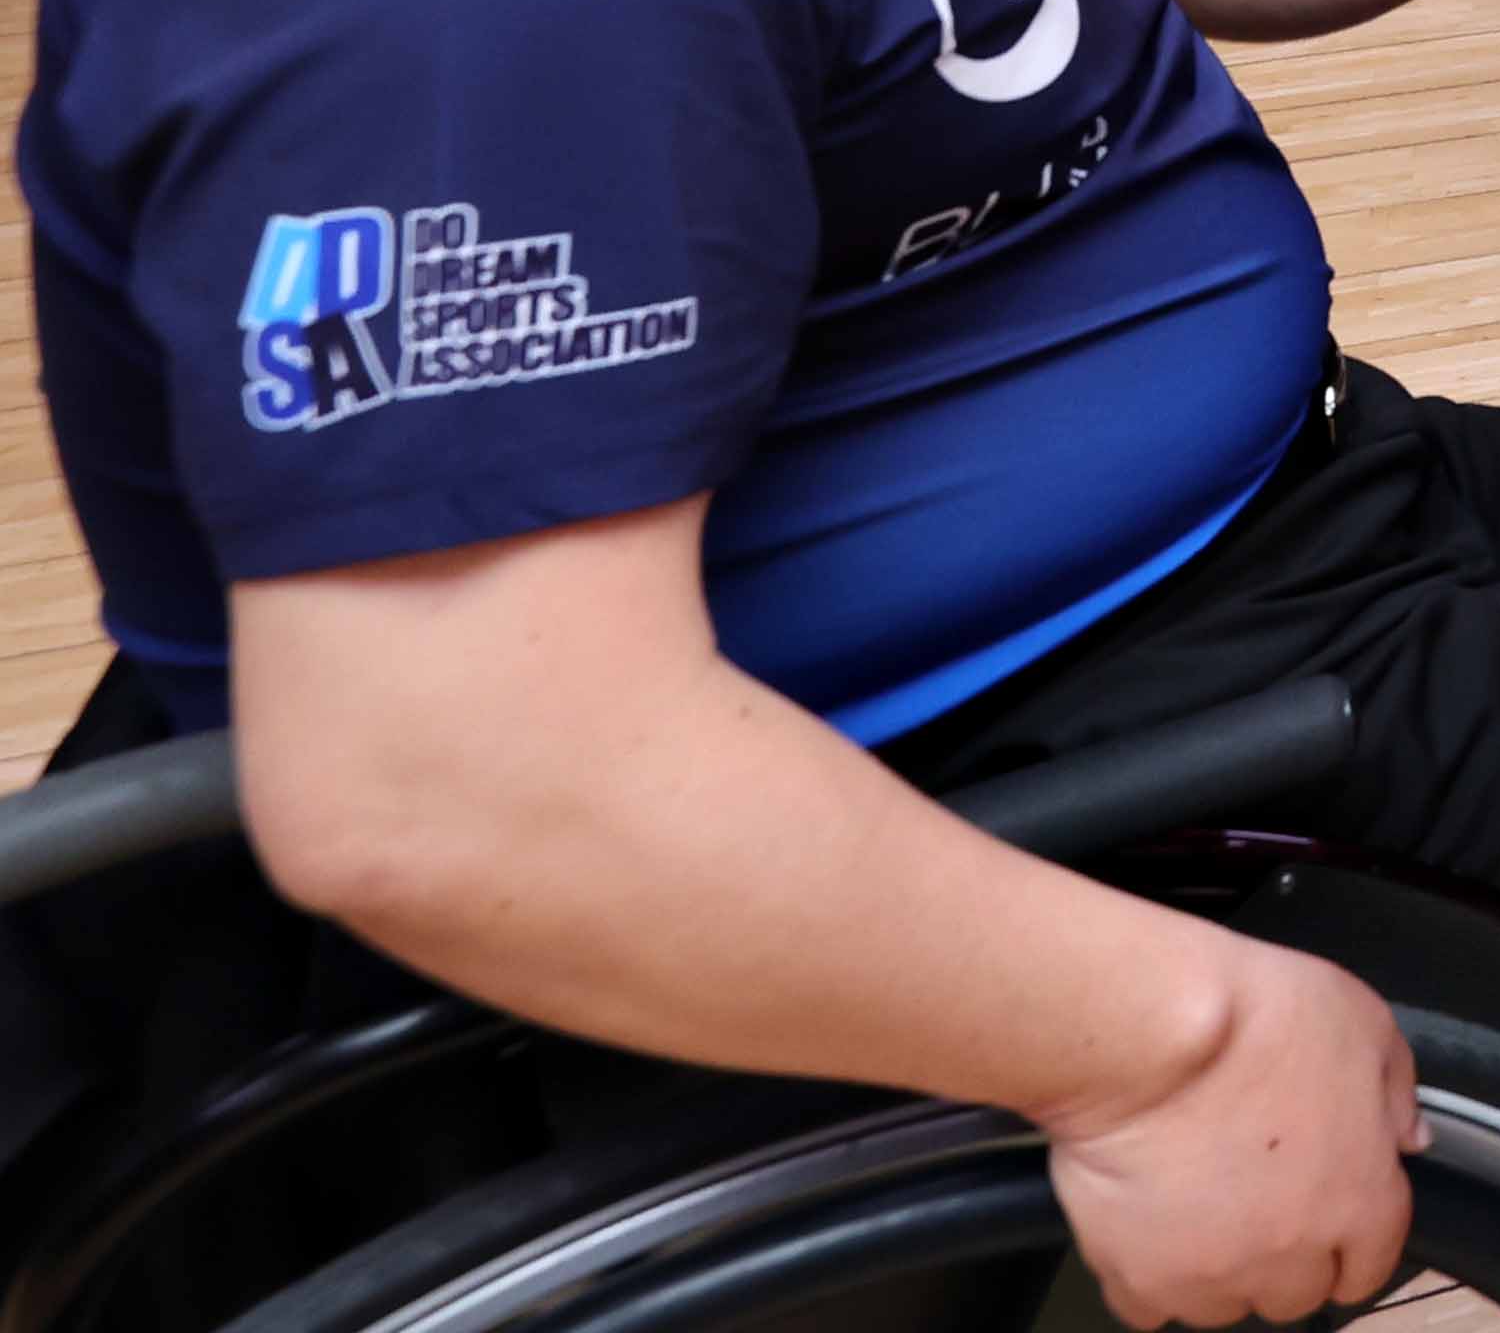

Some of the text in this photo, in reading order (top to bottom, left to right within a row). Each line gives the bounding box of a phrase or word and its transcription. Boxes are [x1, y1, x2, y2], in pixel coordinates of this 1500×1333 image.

[414, 212, 466, 254] DO
[413, 242, 560, 298] DREAM
[412, 283, 577, 340] SPORTS
[410, 305, 690, 388] ASSOCIATION
